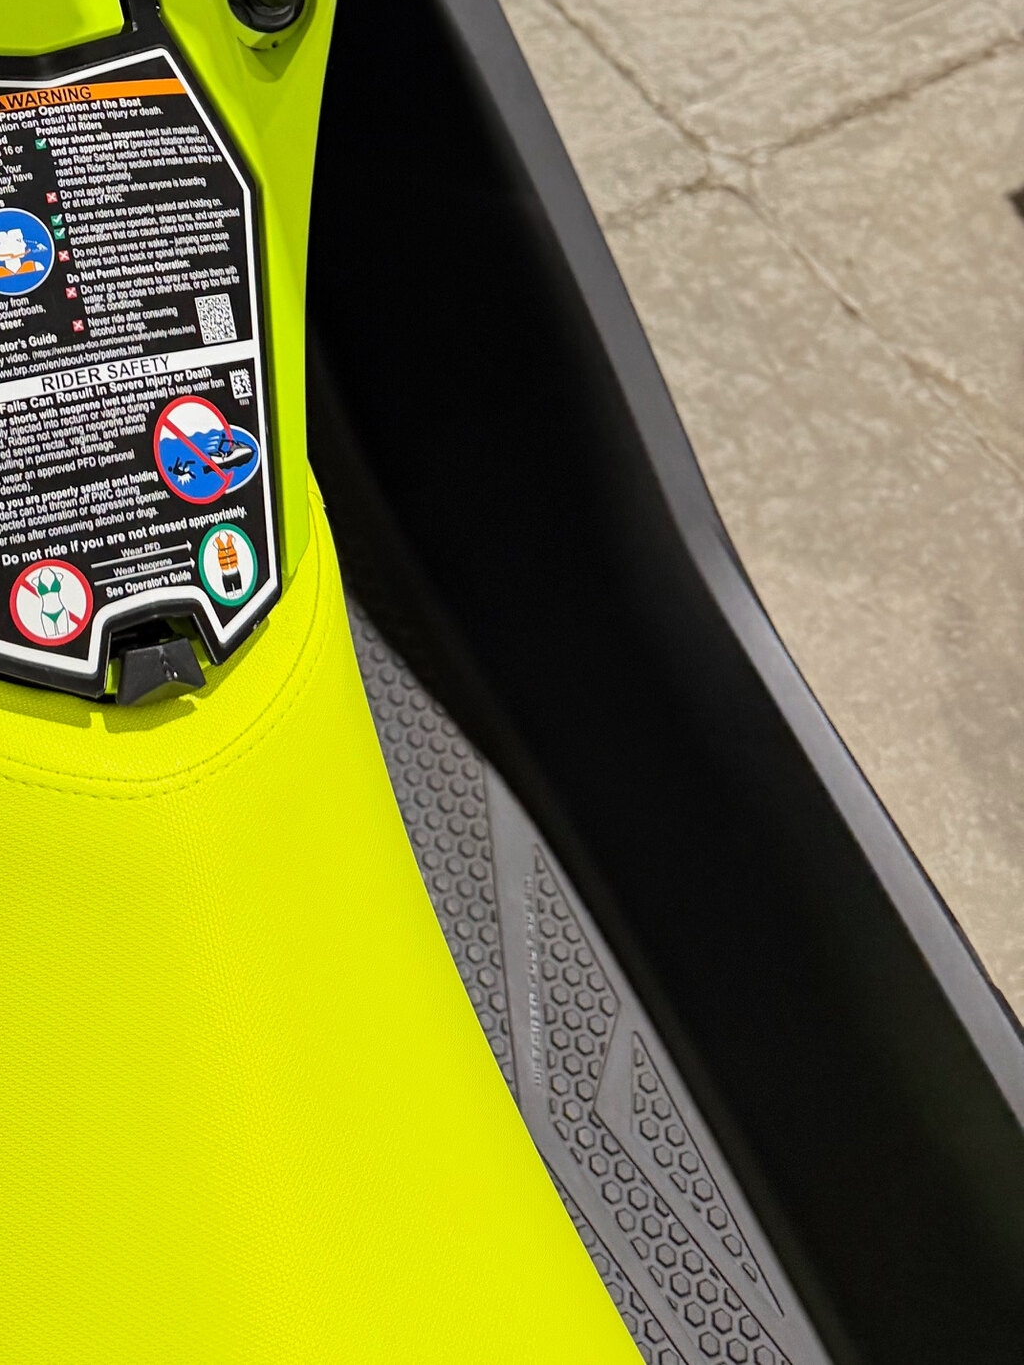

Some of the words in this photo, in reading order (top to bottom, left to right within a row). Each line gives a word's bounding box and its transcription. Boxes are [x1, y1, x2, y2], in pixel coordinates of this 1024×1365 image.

[5, 86, 92, 107] WARNING
[38, 102, 89, 117] Operation
[90, 100, 101, 110] of
[102, 99, 118, 109] the
[119, 96, 141, 107] Boat
[21, 120, 39, 128] can
[41, 114, 66, 125] result
[67, 114, 76, 122] in
[77, 112, 105, 121] severe
[106, 109, 128, 120] injury
[138, 105, 163, 116] death.
[35, 124, 66, 135] Protect
[66, 123, 77, 131] All
[77, 121, 102, 130] Riders
[4, 145, 13, 155] 16
[3, 165, 23, 174] Your
[12, 173, 33, 182] have
[80, 270, 95, 280] Not
[96, 267, 121, 278] Permit
[121, 264, 154, 275] Reckless
[154, 260, 190, 272] Operation:
[10, 298, 29, 307] from
[0, 320, 25, 330] steer.
[28, 334, 57, 346] Guide
[5, 353, 31, 363] video.
[41, 368, 100, 390] RIDER
[106, 355, 171, 378] SAFETY
[29, 397, 53, 408] Can
[55, 387, 94, 403] Result
[95, 386, 107, 396] in
[109, 381, 144, 393] Severe
[145, 376, 173, 388] Injury
[173, 374, 184, 382] or
[185, 367, 212, 380] Death
[6, 499, 24, 511] you
[25, 496, 40, 505] are
[41, 487, 79, 504] properly
[80, 479, 110, 493] seated
[111, 475, 128, 487] and
[129, 471, 159, 483] holding
[9, 534, 26, 544] ride
[27, 530, 46, 540] after
[47, 521, 94, 536] consuming
[94, 513, 125, 526] alcohol
[135, 508, 158, 518] drugs.
[1, 554, 19, 565] Do
[21, 548, 42, 561] not
[44, 545, 68, 557] ride
[69, 541, 78, 552] if
[81, 538, 104, 552] you
[106, 534, 126, 544] are
[128, 527, 147, 540] not
[148, 518, 188, 535] dressed
[188, 507, 248, 528] appropriately.
[120, 546, 143, 556] Wear
[143, 540, 160, 551] PFD
[113, 566, 136, 575] Wear
[136, 558, 172, 570] Neoprene
[105, 587, 124, 597] See
[124, 576, 169, 593] Operator's
[169, 571, 192, 583] Guide
